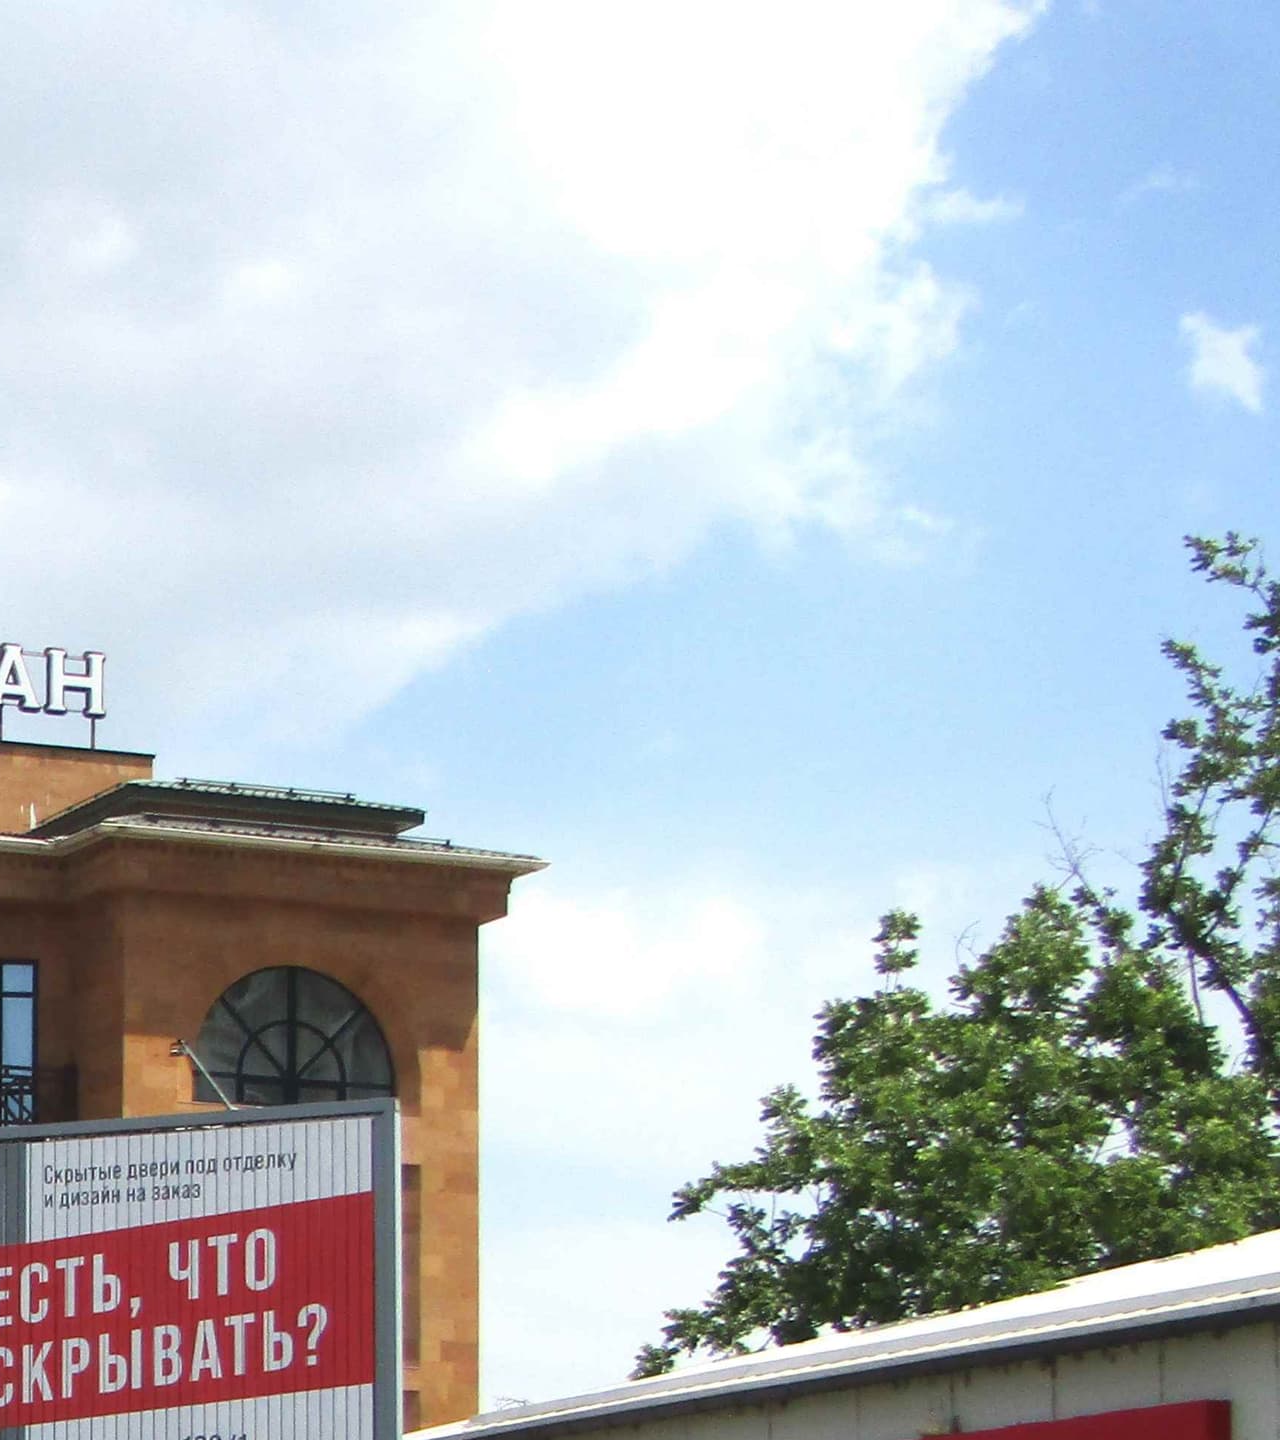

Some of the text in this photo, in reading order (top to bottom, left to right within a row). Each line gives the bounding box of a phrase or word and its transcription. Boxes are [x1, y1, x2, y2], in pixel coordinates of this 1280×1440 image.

[44, 1152, 298, 1186] Скрытые двери под отделку
[44, 1183, 201, 1210] и дизайн на заказ
[168, 1228, 276, 1301] ЧТО
